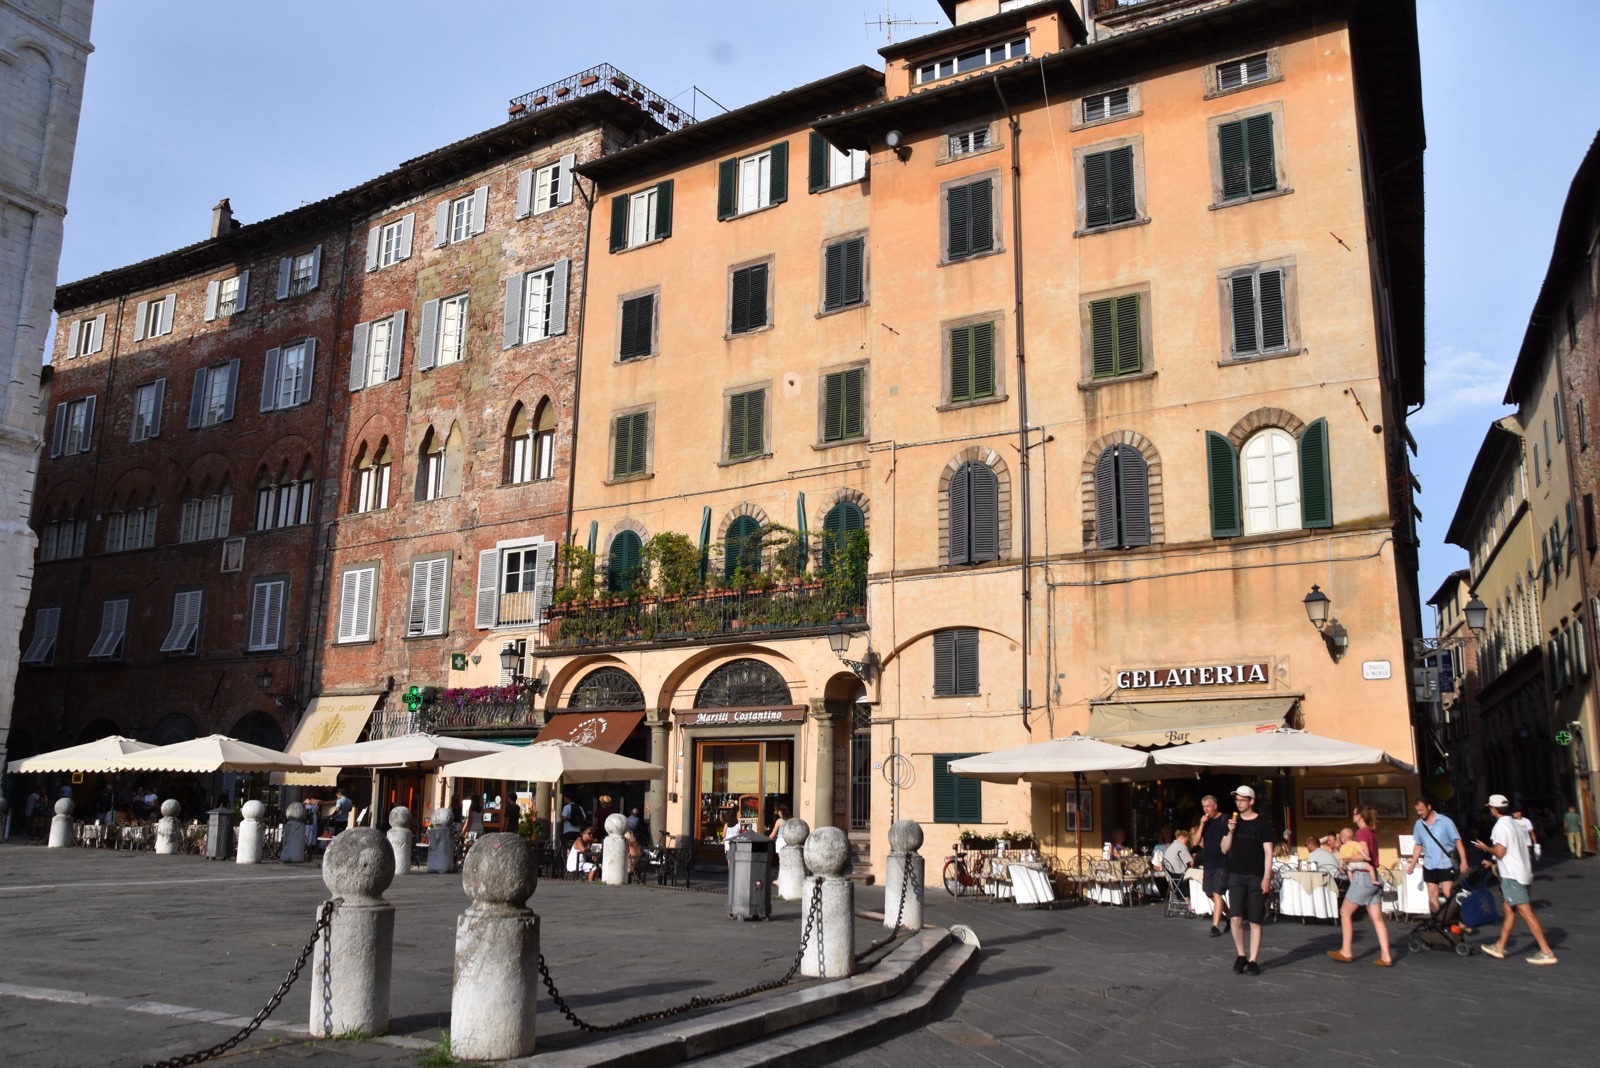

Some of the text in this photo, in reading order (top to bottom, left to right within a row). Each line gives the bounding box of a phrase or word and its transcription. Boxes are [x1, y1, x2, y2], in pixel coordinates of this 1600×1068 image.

[1117, 664, 1268, 690] GELATERIA
[338, 704, 366, 712] FABBRICA
[697, 711, 782, 722] Marsili Costantino
[1165, 731, 1191, 742] Bar
